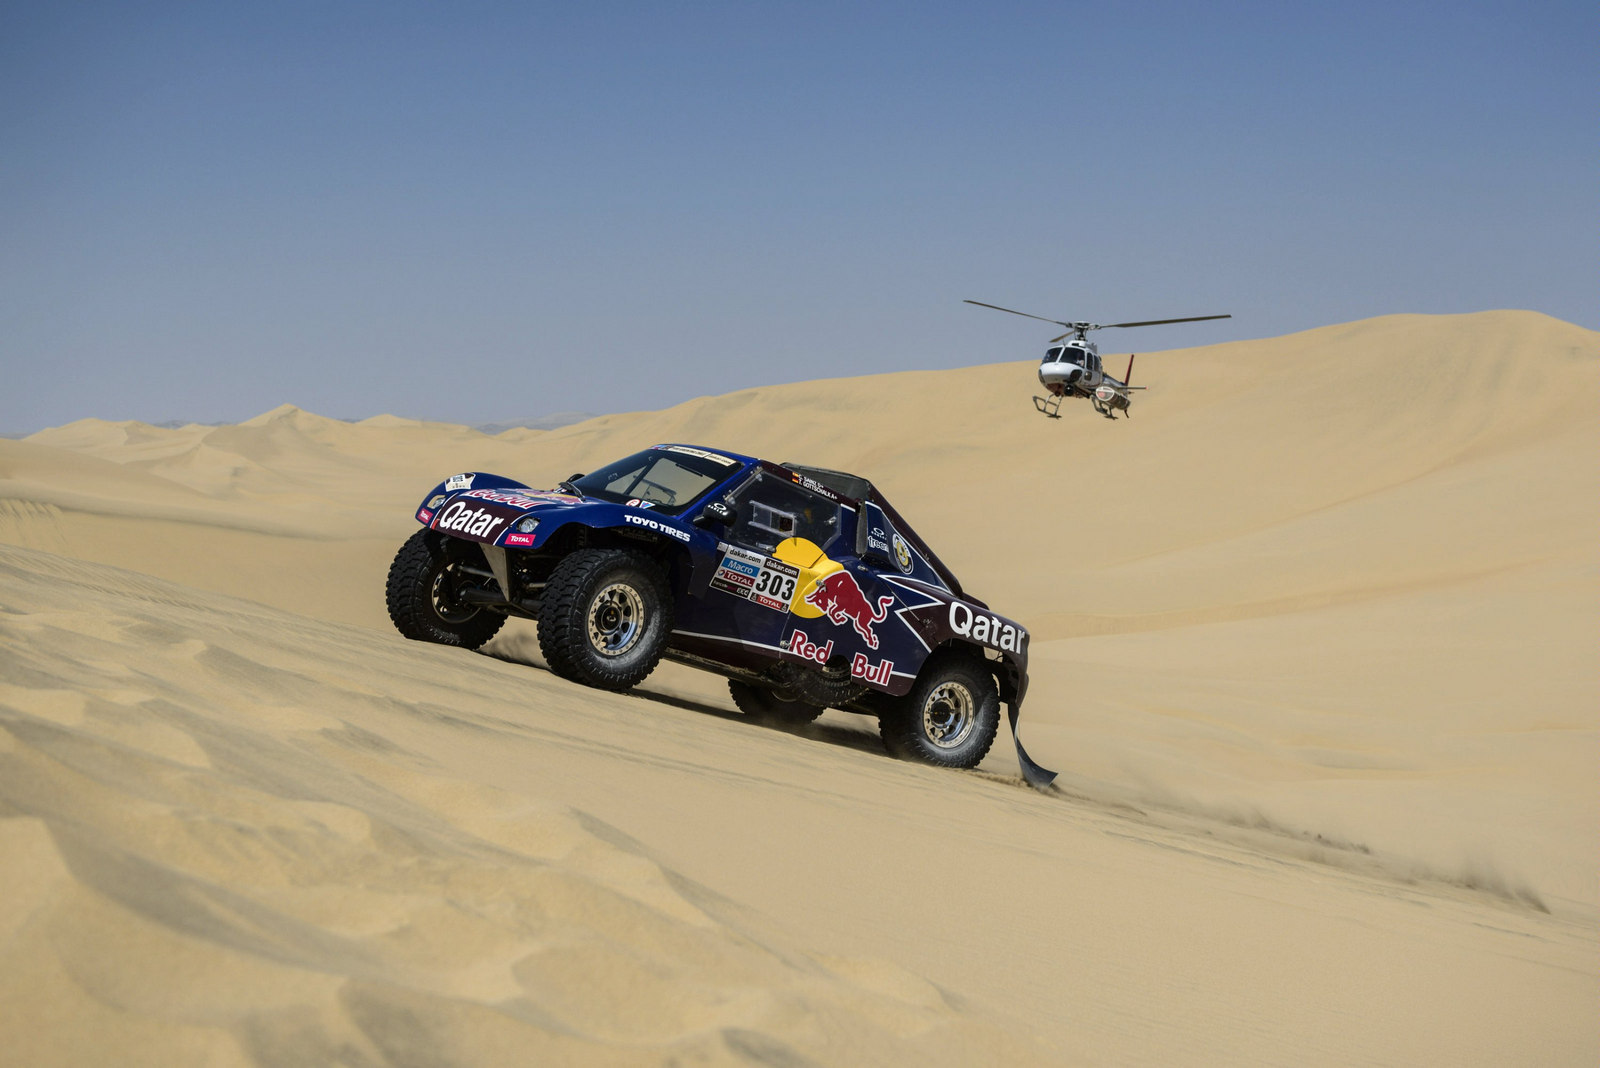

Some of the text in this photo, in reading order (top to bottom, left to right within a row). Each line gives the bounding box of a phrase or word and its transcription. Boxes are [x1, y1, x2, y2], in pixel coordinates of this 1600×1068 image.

[439, 501, 504, 538] Qatar
[624, 514, 691, 542] TOYO TIRES
[510, 535, 530, 543] TOTAL
[729, 548, 762, 564] dakar.com
[727, 560, 754, 574] Macro
[766, 560, 798, 576] dakar.com
[726, 571, 753, 586] TOTAL
[755, 571, 796, 601] 303
[759, 597, 781, 609] TOTAL
[949, 601, 1026, 654] Qatar
[788, 629, 894, 686] Red Bull
